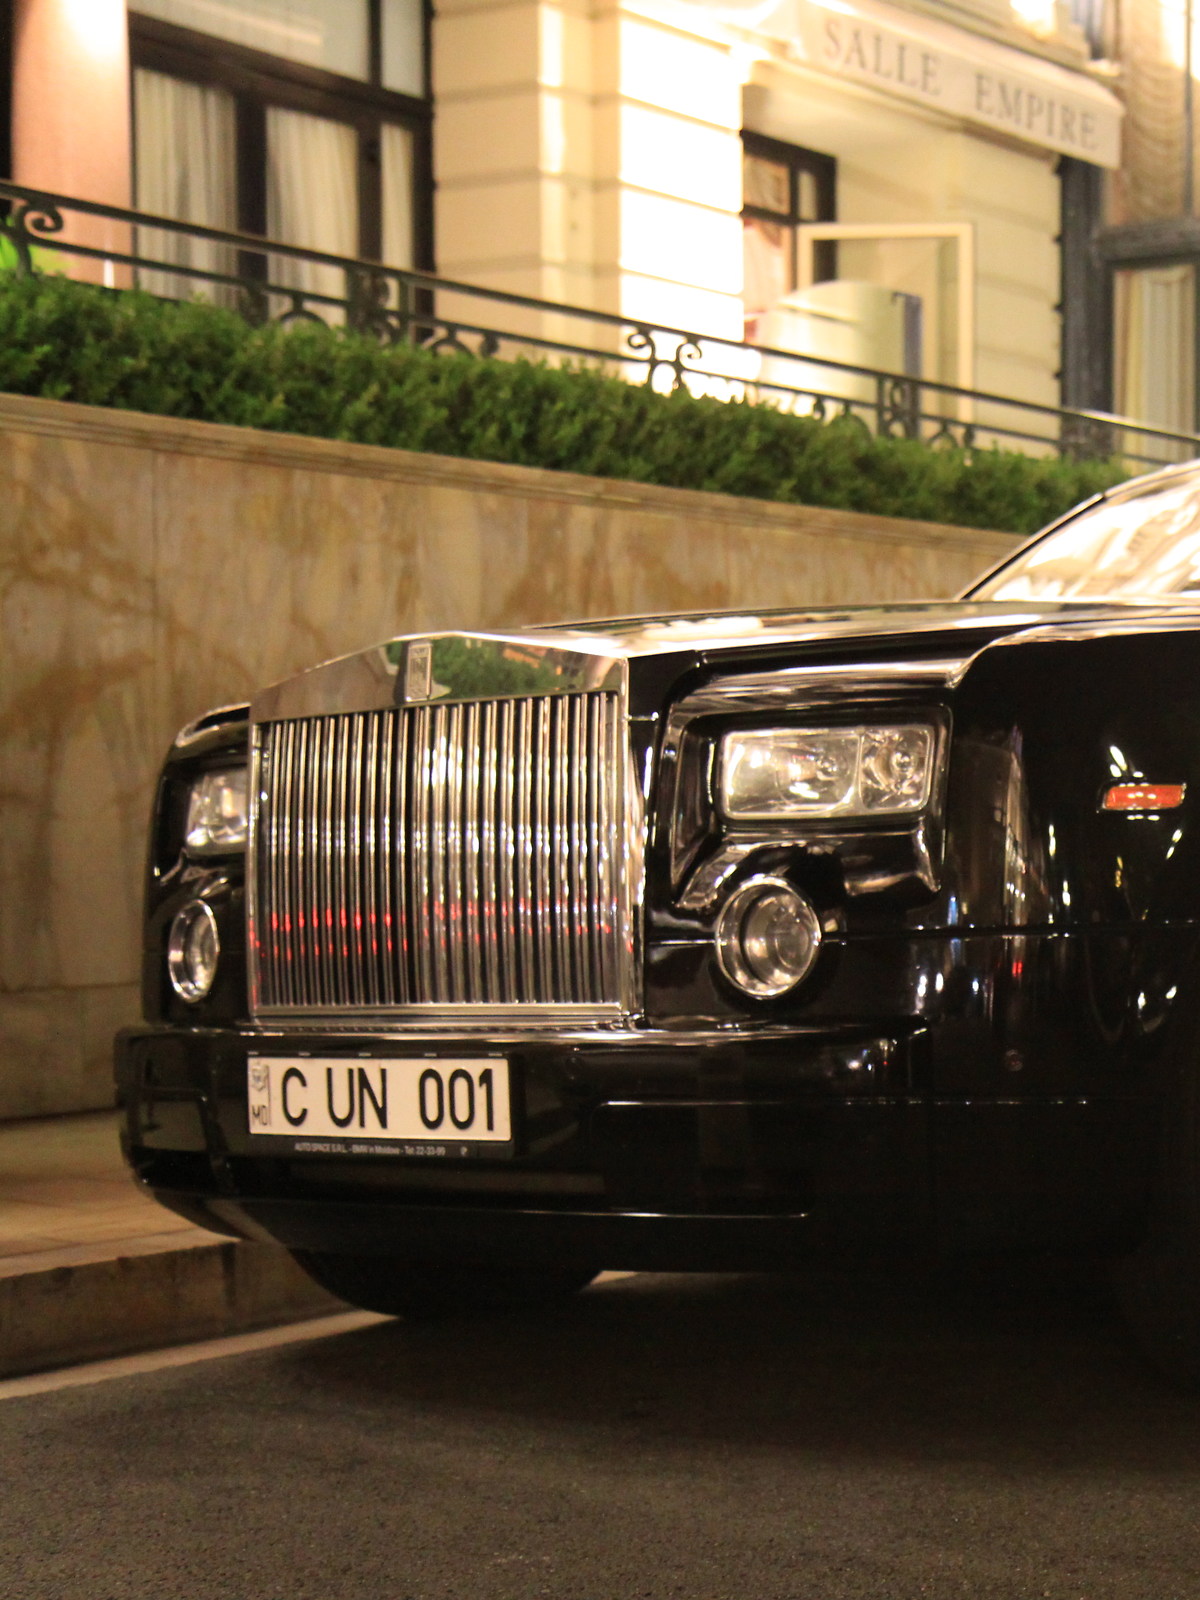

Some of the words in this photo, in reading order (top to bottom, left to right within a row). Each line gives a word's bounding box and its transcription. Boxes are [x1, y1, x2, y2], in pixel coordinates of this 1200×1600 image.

[824, 18, 941, 96] SALLE
[975, 71, 1099, 151] EMPIRE
[282, 1067, 307, 1127] C
[326, 1067, 387, 1129] UN
[419, 1068, 494, 1131] 001
